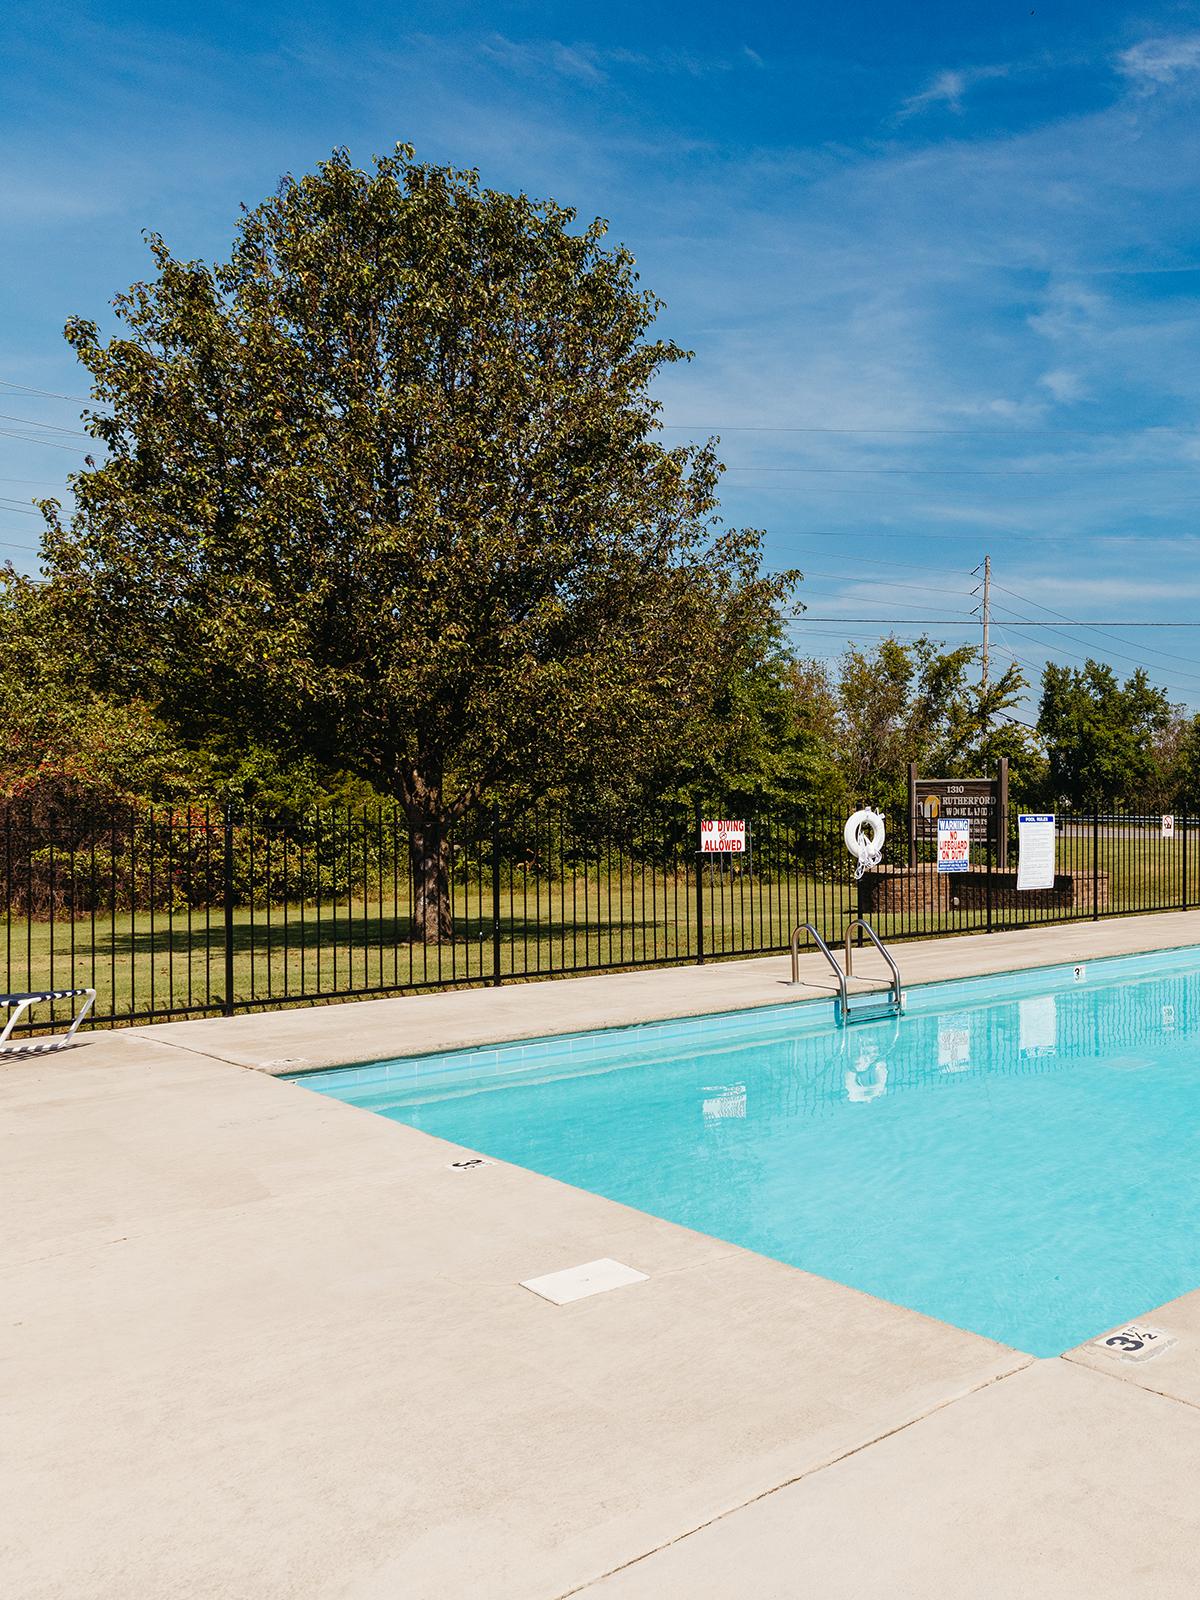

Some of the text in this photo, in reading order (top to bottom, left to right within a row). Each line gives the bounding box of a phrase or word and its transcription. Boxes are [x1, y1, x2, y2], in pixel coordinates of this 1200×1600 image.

[947, 785, 965, 793] 1310
[943, 797, 997, 805] RUTHERFORD
[702, 820, 745, 832] NO DIVING
[939, 820, 968, 830] WARNING
[950, 831, 957, 840] NO
[704, 840, 742, 851] ALLOWED
[940, 841, 967, 850] LIFEGUARD
[942, 850, 964, 860] ON DUTY
